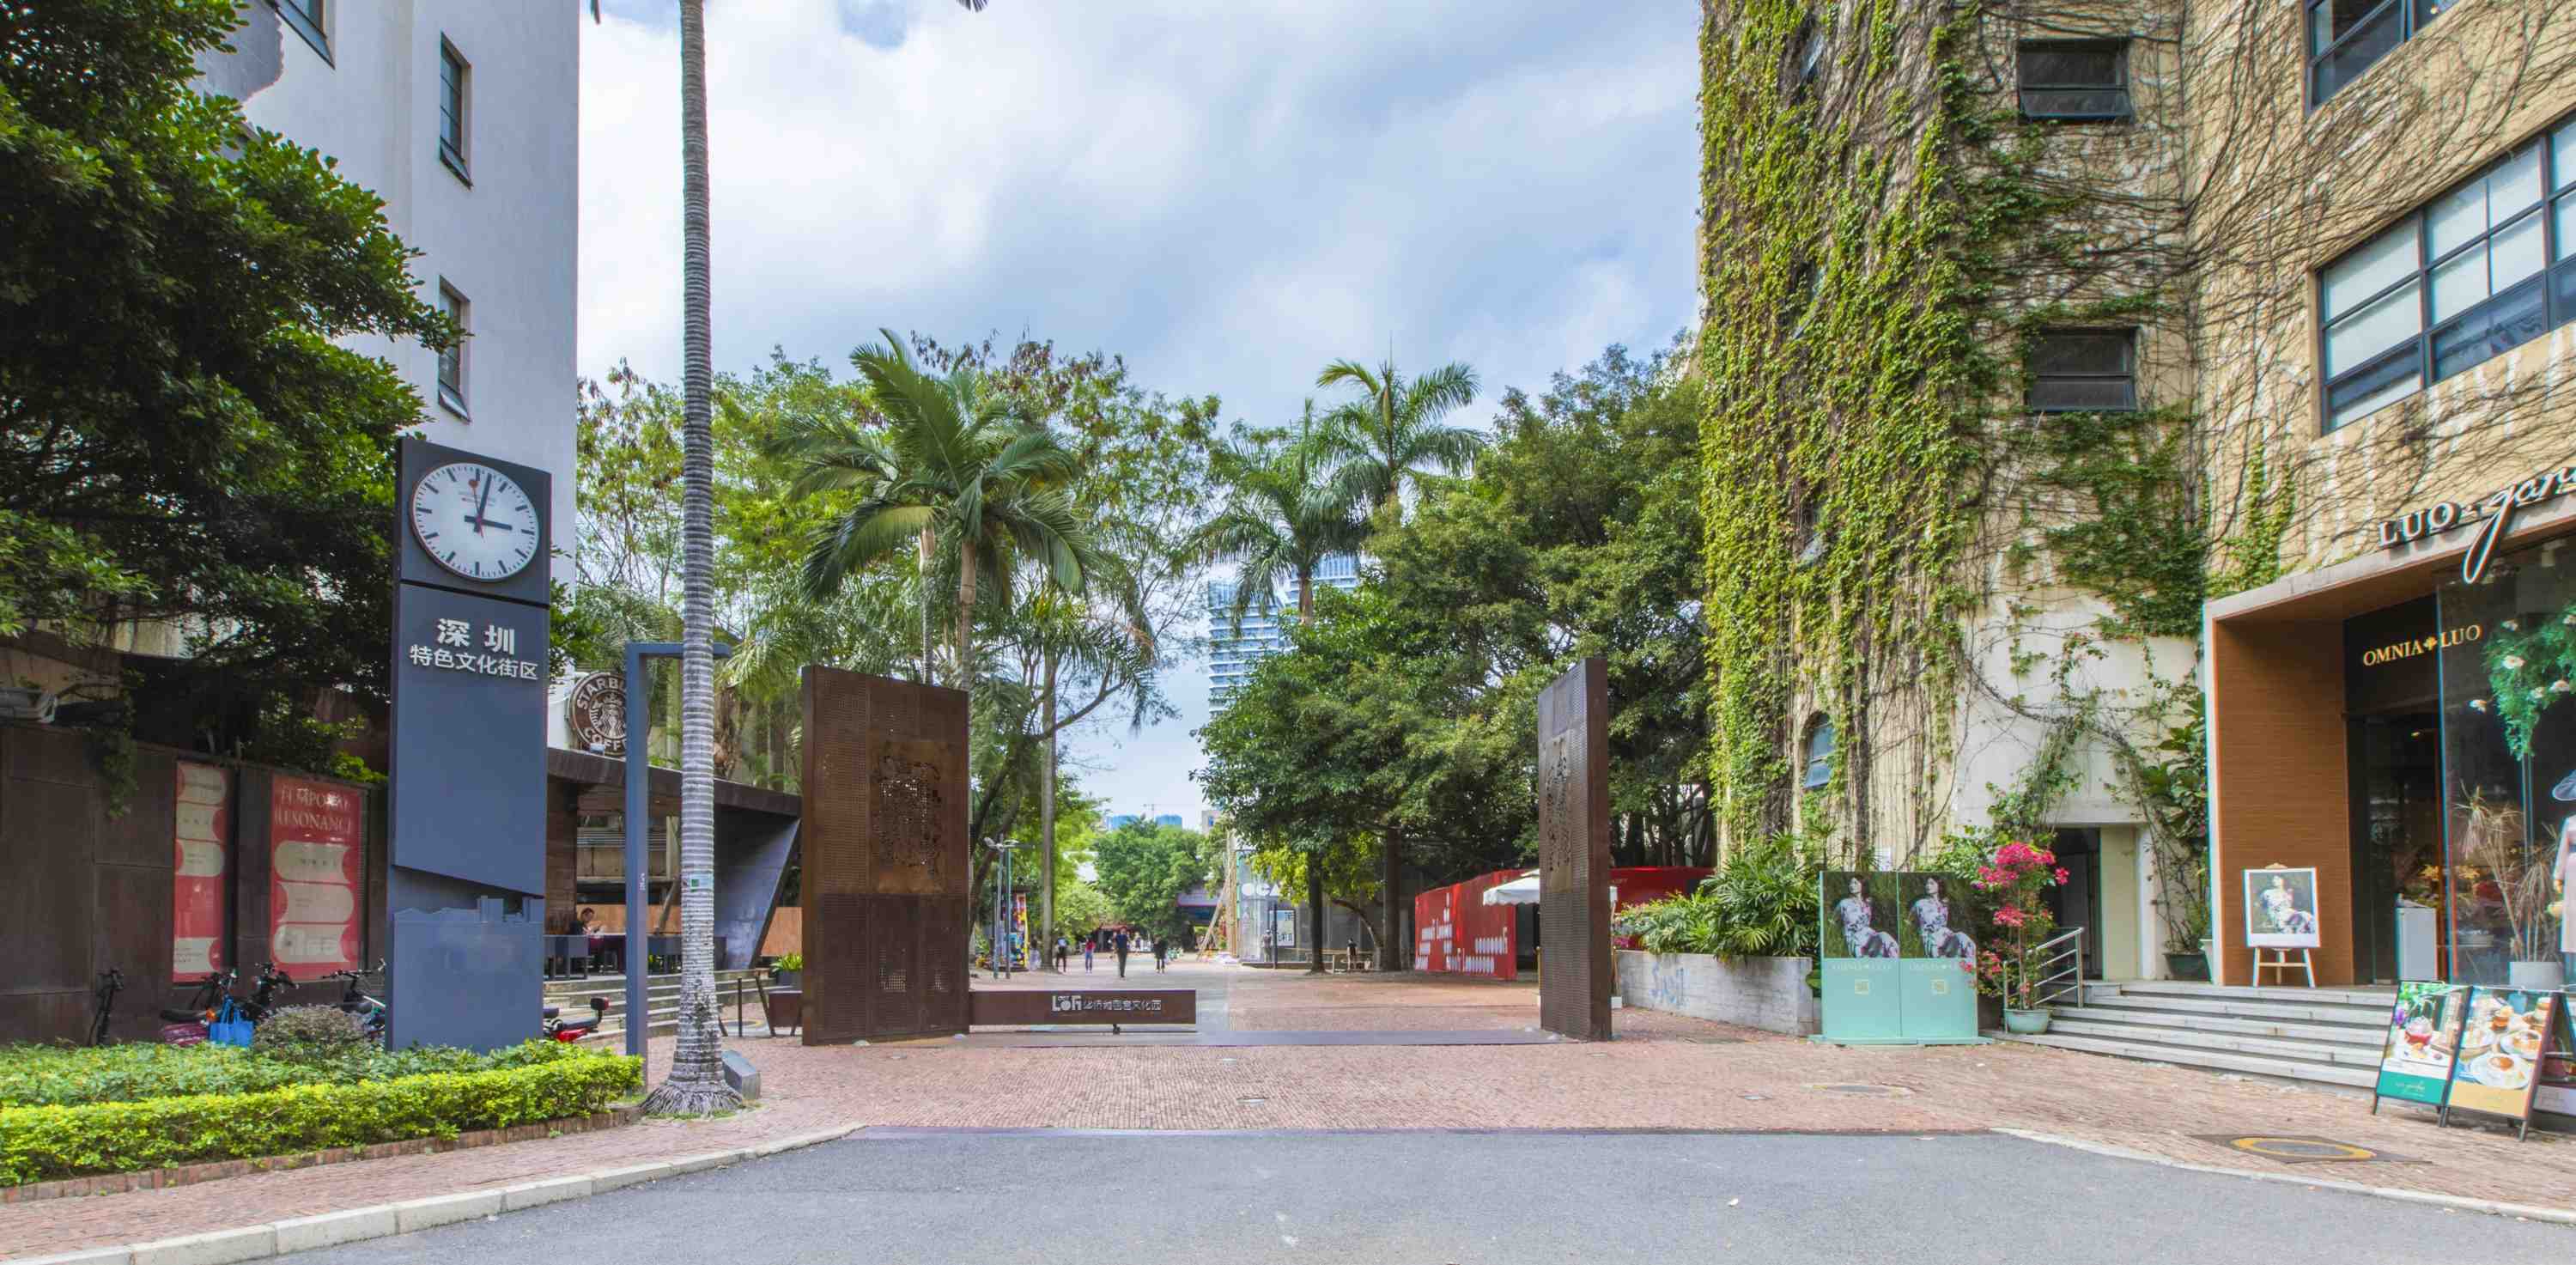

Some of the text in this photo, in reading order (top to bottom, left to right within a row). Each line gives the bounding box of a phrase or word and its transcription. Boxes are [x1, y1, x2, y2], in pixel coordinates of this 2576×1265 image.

[2379, 502, 2458, 546] LUO
[437, 617, 515, 655] 深圳
[2363, 624, 2481, 666] OMNIA LUO
[409, 644, 539, 680] 特色文化街区
[577, 677, 626, 709] STARB
[584, 727, 626, 751] COFF
